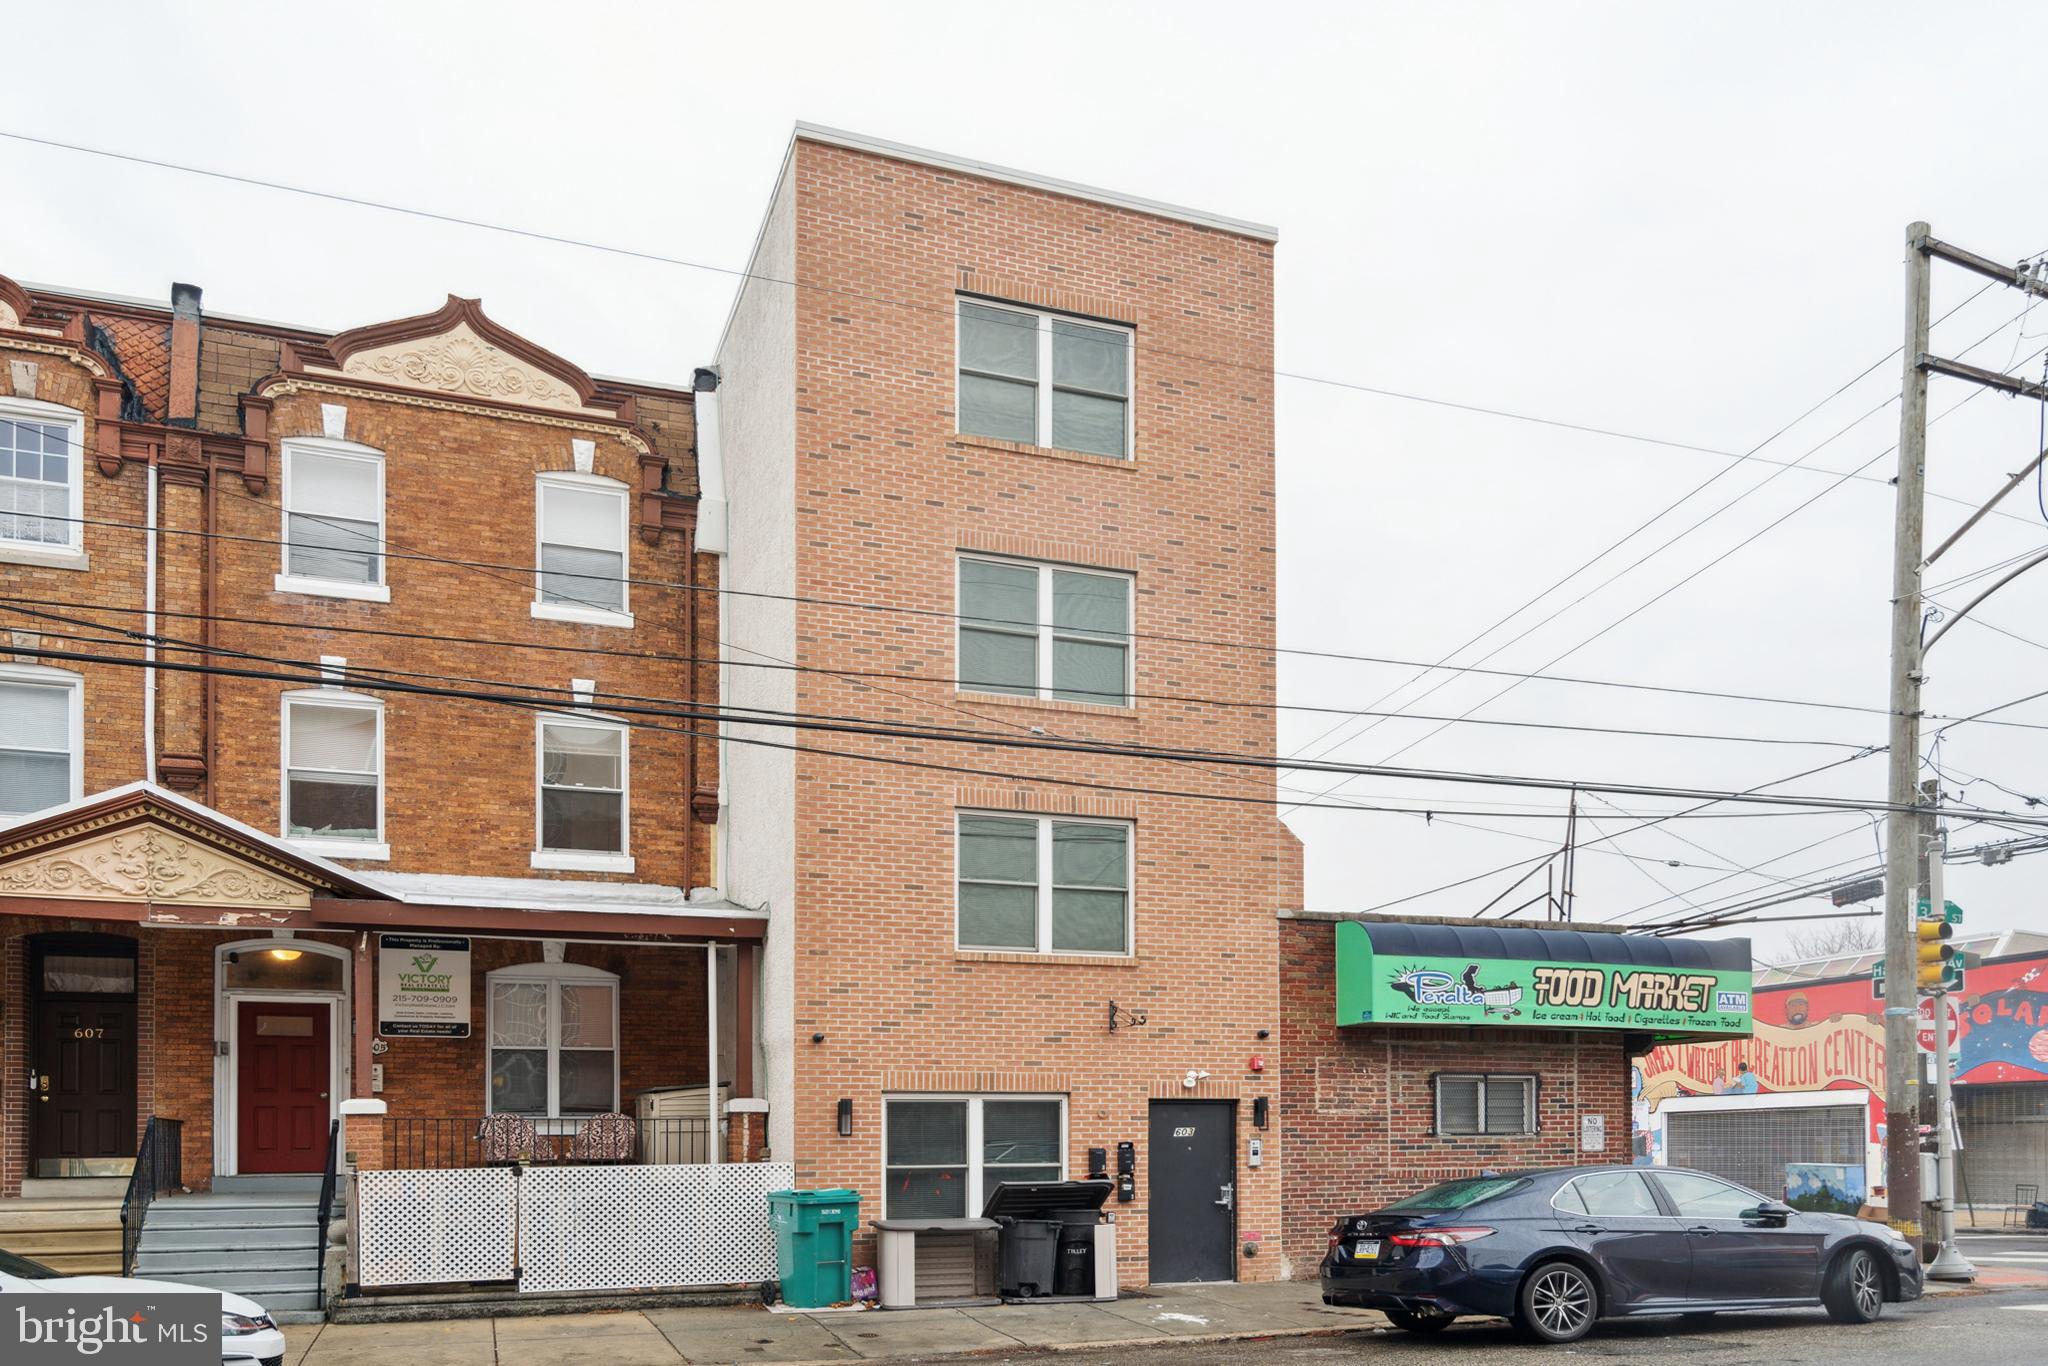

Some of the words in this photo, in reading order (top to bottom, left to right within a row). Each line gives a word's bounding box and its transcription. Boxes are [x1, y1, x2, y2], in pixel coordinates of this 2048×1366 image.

[398, 973, 453, 985] VICTORY
[1406, 970, 1485, 1005] Peralta
[1533, 967, 1605, 1007] FOOD
[1609, 970, 1718, 1012] MARKET
[392, 994, 458, 1004] 215-709-0909
[1719, 994, 1746, 1005] ATM
[1442, 1013, 1471, 1021] Stamps
[1532, 1009, 1547, 1020] Ice
[1550, 1012, 1578, 1021] cream
[1585, 1011, 1602, 1022] Hot
[1605, 1013, 1625, 1023] Food
[1634, 1012, 1680, 1026] Cigarettes
[1688, 1015, 1717, 1027] Frozen
[1721, 1017, 1741, 1028] Food
[74, 1028, 105, 1039] 607
[1643, 1043, 1675, 1079] JAMES
[1731, 1036, 1818, 1087] RECREATION
[1823, 1028, 1887, 1088] CENTER
[1175, 1127, 1194, 1136] 603
